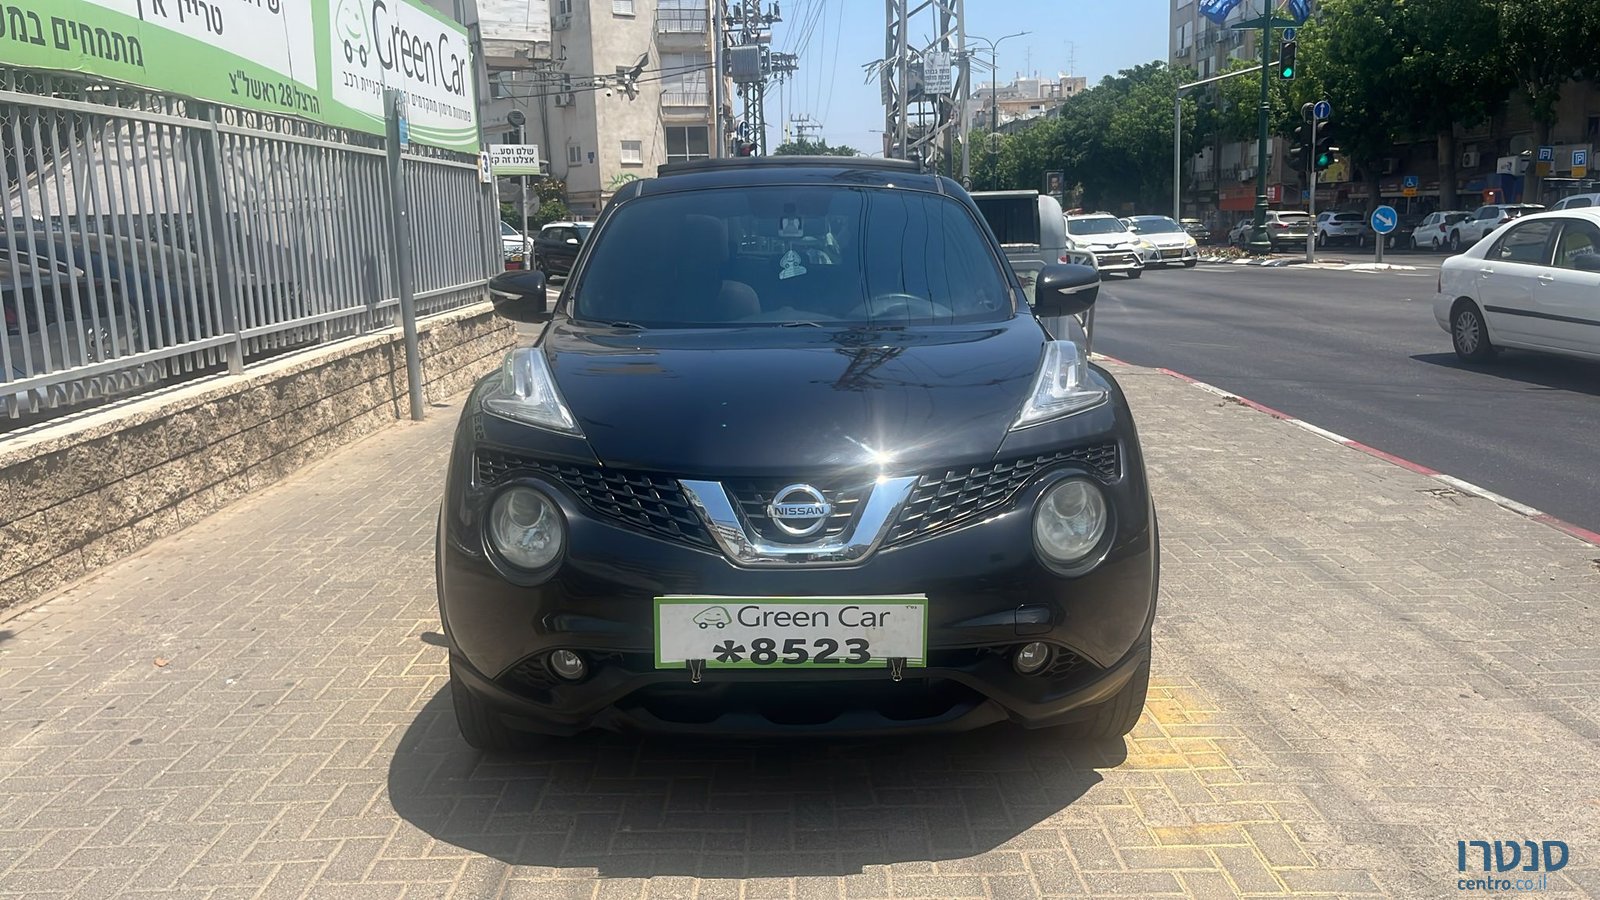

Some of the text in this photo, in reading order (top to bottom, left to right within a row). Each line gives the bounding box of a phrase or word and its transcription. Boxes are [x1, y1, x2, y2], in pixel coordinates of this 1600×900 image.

[0, 4, 144, 67] מתמחים במ
[372, 0, 466, 97] Green Car
[343, 71, 359, 89] רכב
[279, 82, 293, 107] 28
[294, 86, 320, 114] הרצל
[513, 156, 535, 164] אצלנו
[516, 147, 534, 156] שלם
[774, 506, 825, 516] NISSAN
[737, 605, 891, 628] Green Car
